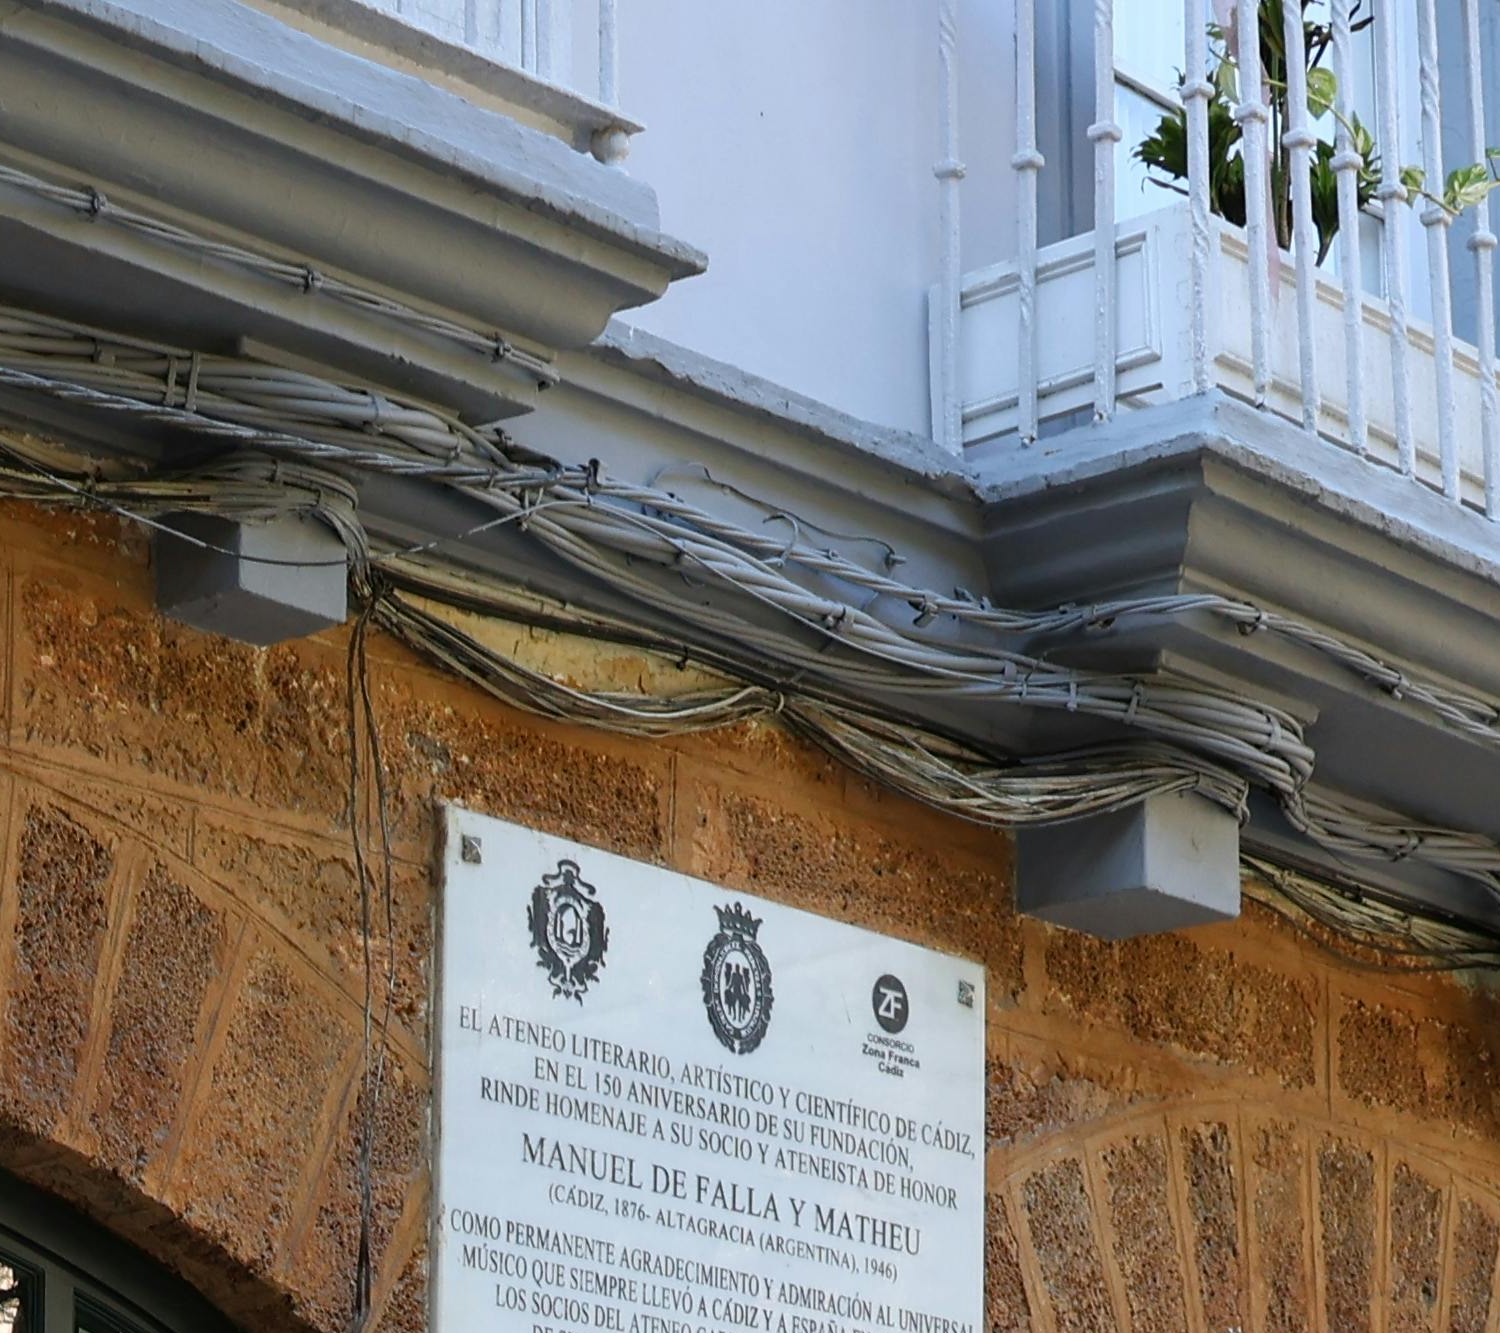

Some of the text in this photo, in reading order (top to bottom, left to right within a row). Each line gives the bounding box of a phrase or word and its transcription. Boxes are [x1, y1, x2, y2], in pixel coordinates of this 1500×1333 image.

[866, 1032, 914, 1054] CONSORCIO
[878, 986, 902, 1019] ZF
[459, 1005, 975, 1159] EL ATENEO LITERARIO, ARTÍSTICO Y CIENTÍFICO DE CÁDIZ,
[861, 1042, 920, 1069] Zona Franca
[877, 1060, 904, 1078] Cádiz
[480, 1075, 957, 1210] RINDE HOMENAJE A SU SOCIO Y ATENEISTA DE HONOR
[534, 1055, 913, 1172] EN EL 150 ANIVERSARIO DE SU FUNDACIÓN,
[522, 1132, 920, 1255] MANUEL DE FALLA Y MATHEU
[548, 1183, 608, 1216] (CÁDIZ,
[614, 1197, 651, 1221] 1876-
[655, 1208, 755, 1247] ALTAGRACIA
[864, 1256, 897, 1282] 1946)
[450, 1208, 501, 1240] COMO
[505, 1219, 615, 1265] PERMANENTE
[618, 1246, 759, 1297] AGRADECIMIENTO
[762, 1276, 774, 1300] Y
[777, 1281, 872, 1322] ADMIRACIÓN
[875, 1304, 895, 1327] AL
[462, 1243, 527, 1279] MÚSICO
[531, 1258, 565, 1288] QUE
[569, 1267, 637, 1303] SIEMPRE
[641, 1282, 693, 1314] LLEVÓ
[696, 1295, 707, 1318] A
[711, 1297, 759, 1329] CÁDIZ
[762, 1308, 773, 1331] Y
[495, 1283, 527, 1312] LOS
[530, 1290, 589, 1325] SOCIOS
[594, 1303, 624, 1332] DEL
